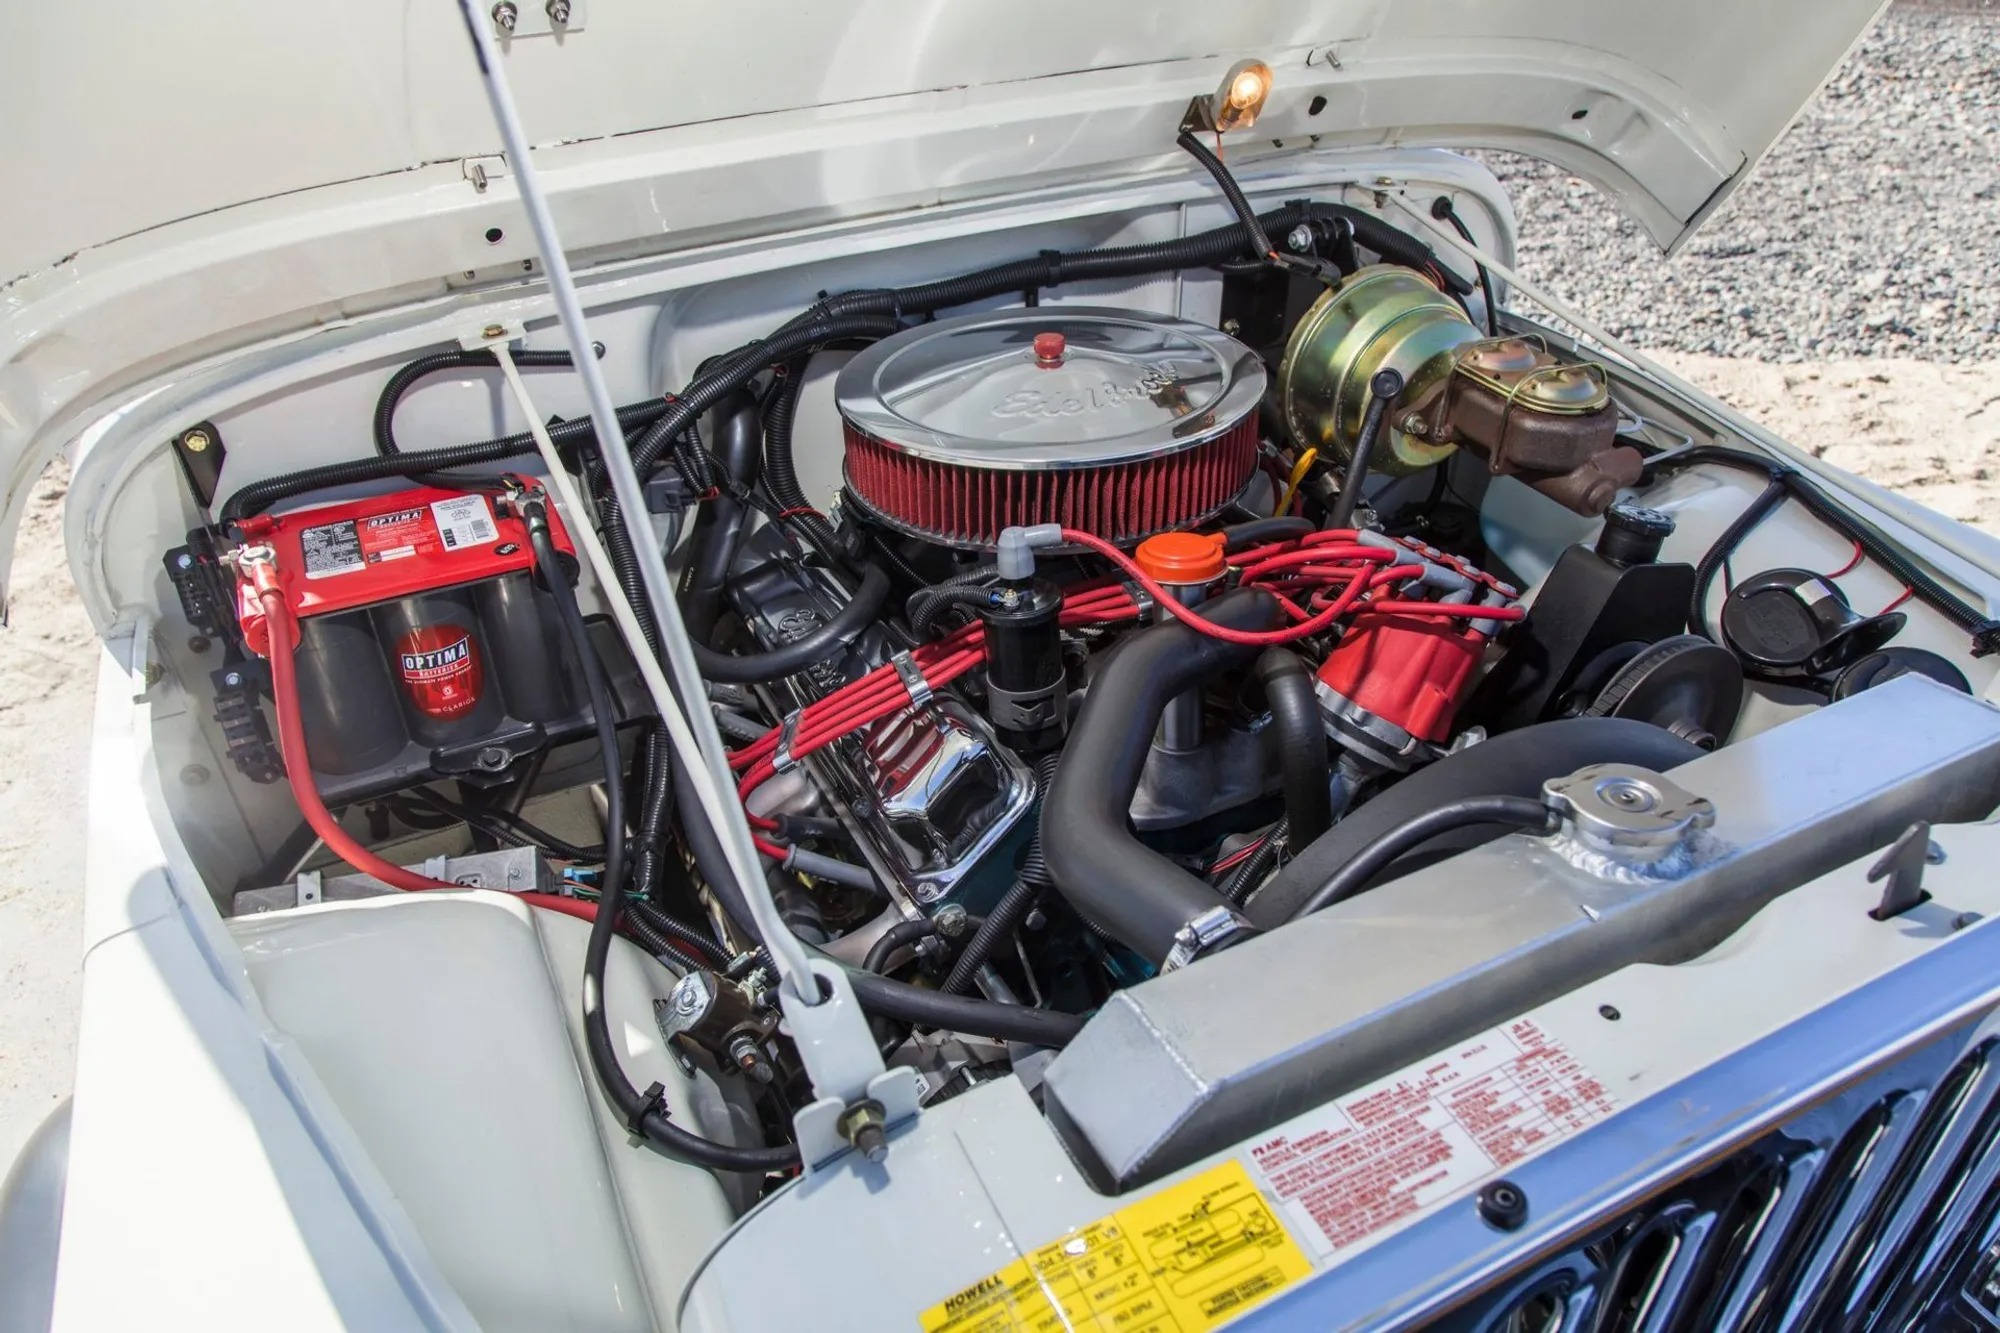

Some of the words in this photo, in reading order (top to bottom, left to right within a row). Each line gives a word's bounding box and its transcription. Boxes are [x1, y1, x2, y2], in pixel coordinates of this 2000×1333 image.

[369, 511, 421, 528] OPTIMA
[404, 643, 467, 670] OPTIMA
[442, 696, 476, 712] CLARIOS
[944, 1274, 1004, 1312] HOWELL
